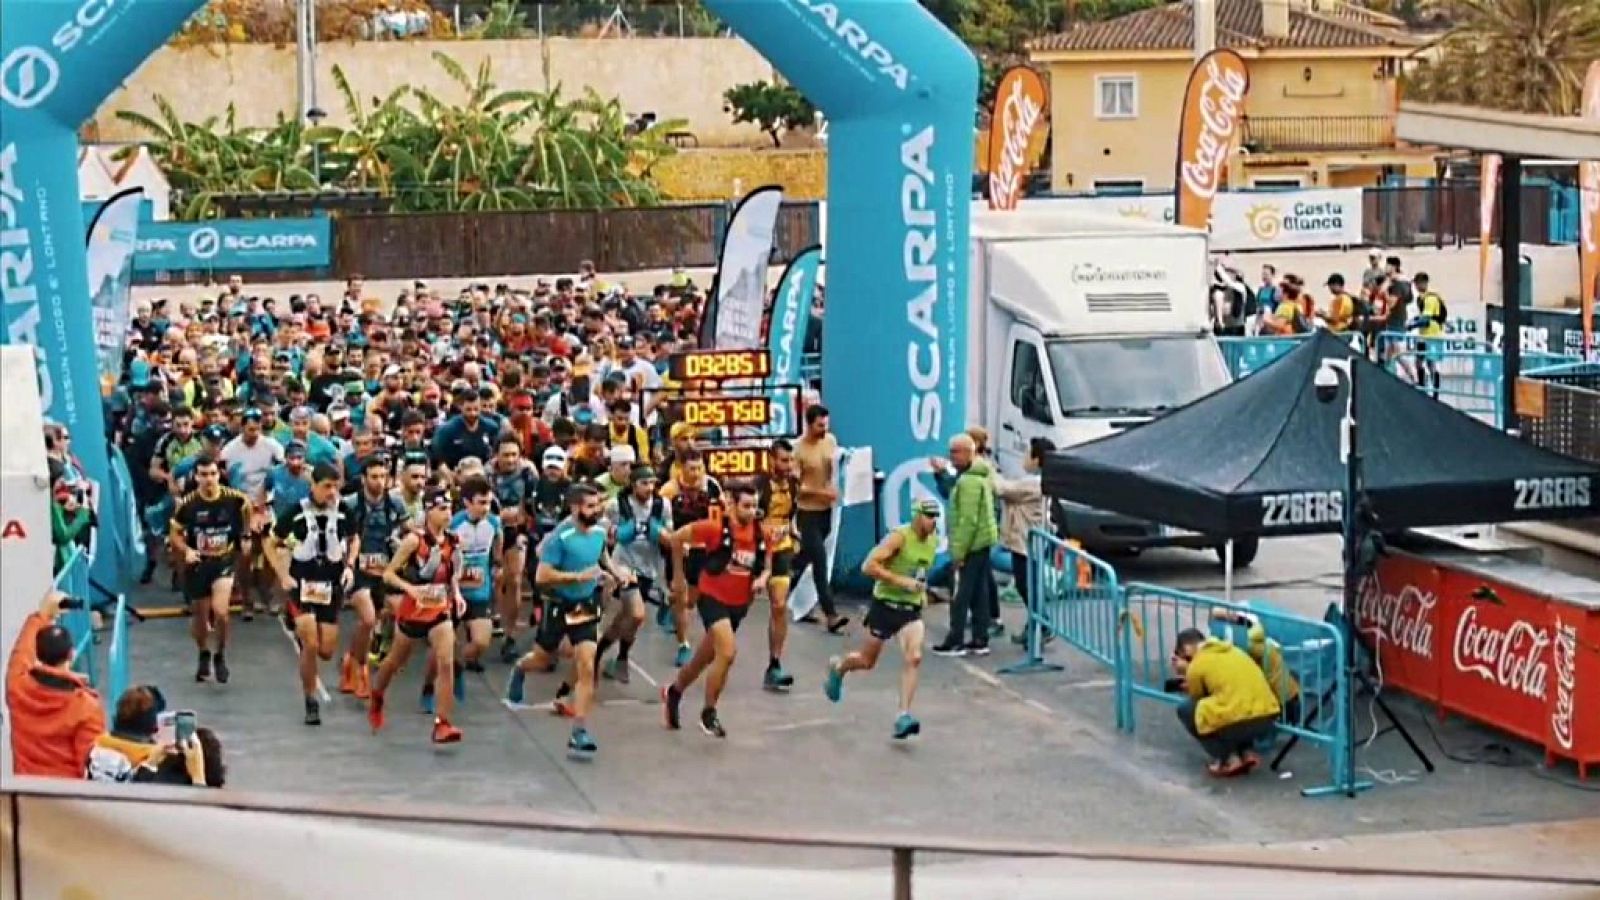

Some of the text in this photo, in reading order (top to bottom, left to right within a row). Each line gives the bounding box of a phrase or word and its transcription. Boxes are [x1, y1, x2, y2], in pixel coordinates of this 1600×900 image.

[52, 0, 115, 53] SC
[797, 0, 909, 91] ARPA
[1283, 216, 1344, 232] Blanca
[1294, 202, 1343, 216] Costa
[223, 234, 318, 250] SCARPA
[0, 141, 55, 434] ARPA
[901, 124, 942, 442] SCARPA
[685, 352, 767, 377] 092851
[685, 400, 765, 425] 025758
[1262, 491, 1344, 526] 226ERS
[1513, 476, 1592, 510] 226ERS
